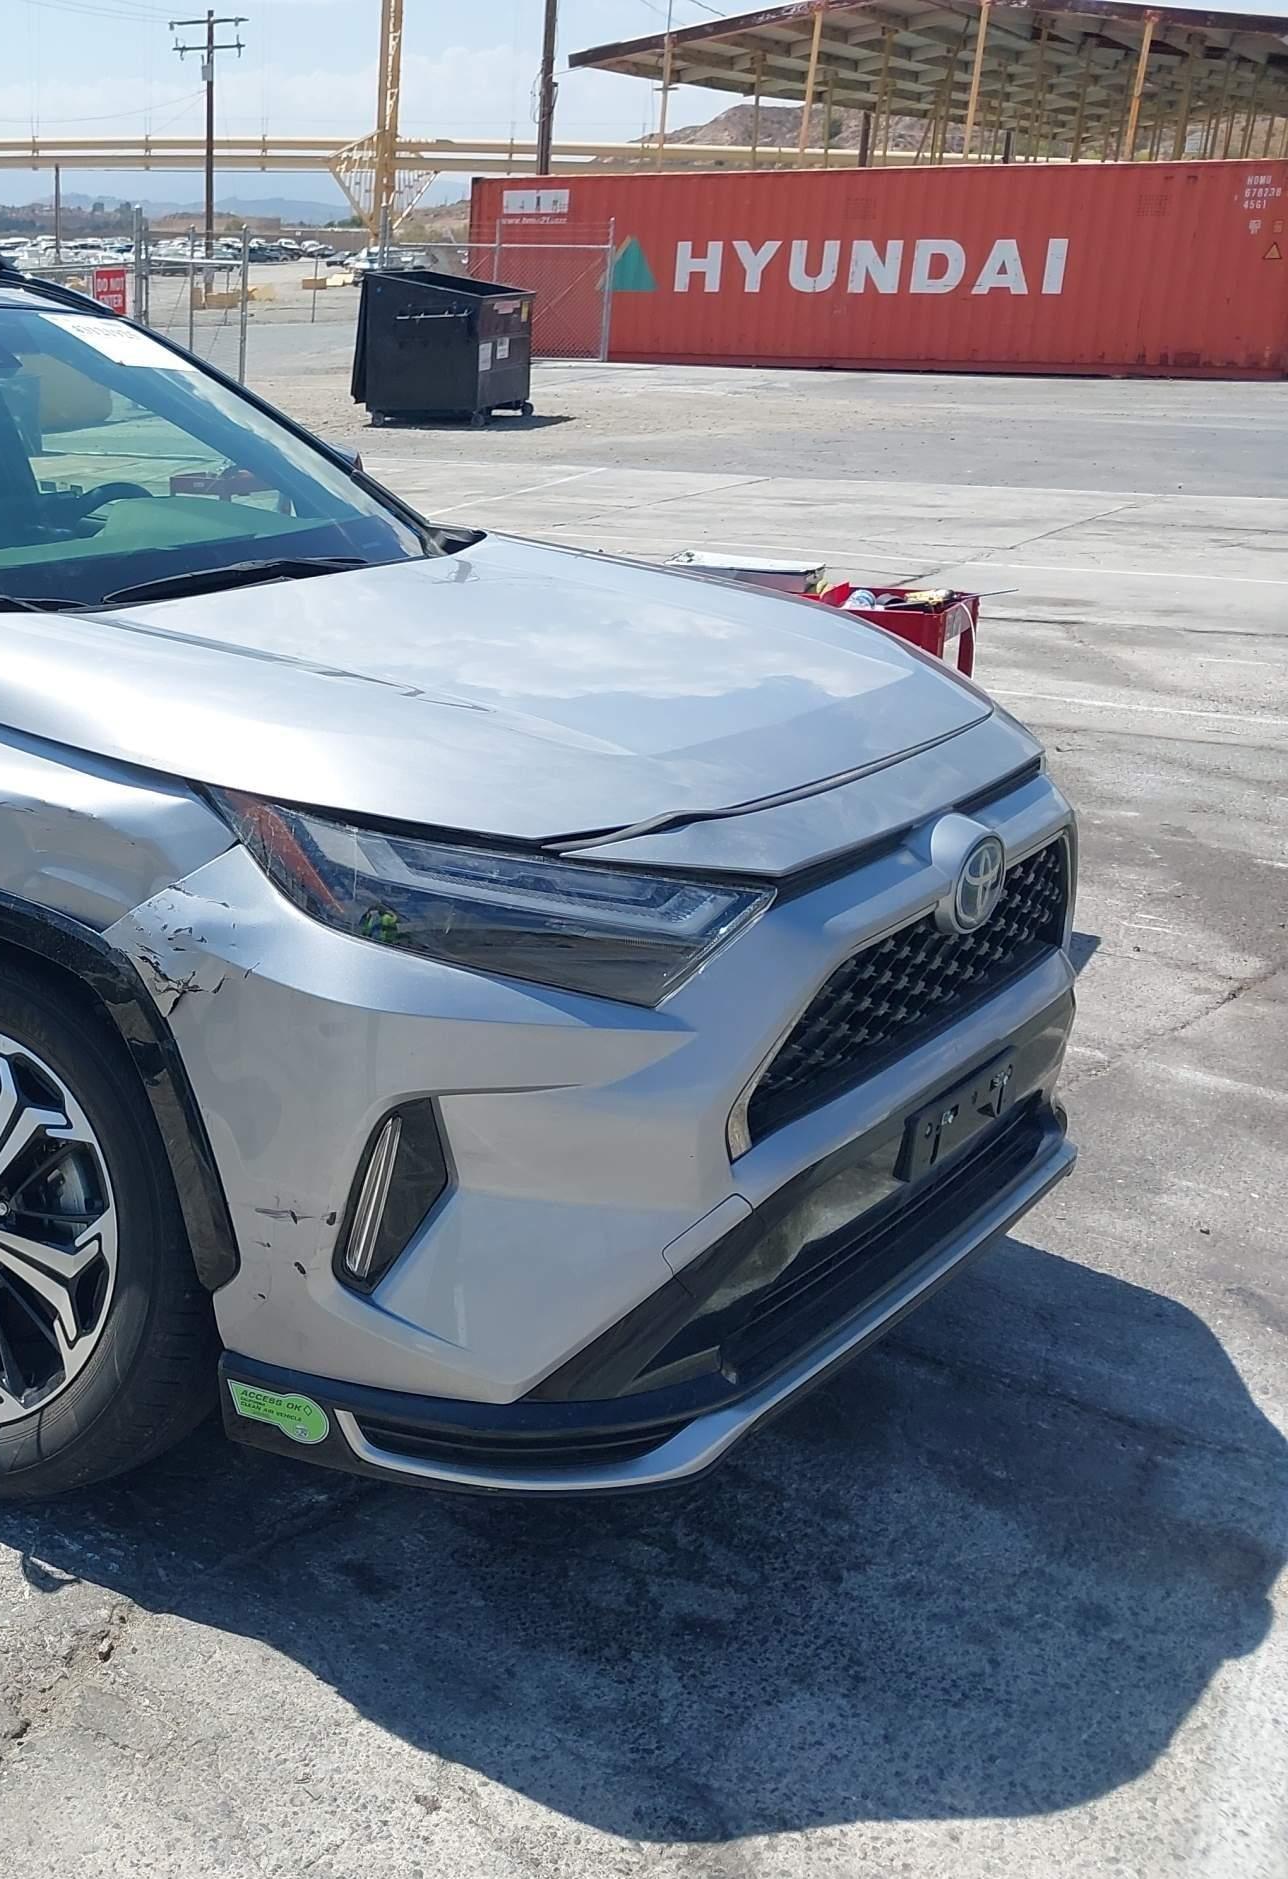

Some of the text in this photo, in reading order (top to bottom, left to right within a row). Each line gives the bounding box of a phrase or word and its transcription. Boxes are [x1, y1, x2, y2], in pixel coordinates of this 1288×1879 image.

[674, 238, 1070, 295] HYUNDAI
[96, 277, 124, 292] DO NOT
[240, 1389, 302, 1412] ACCESS OK
